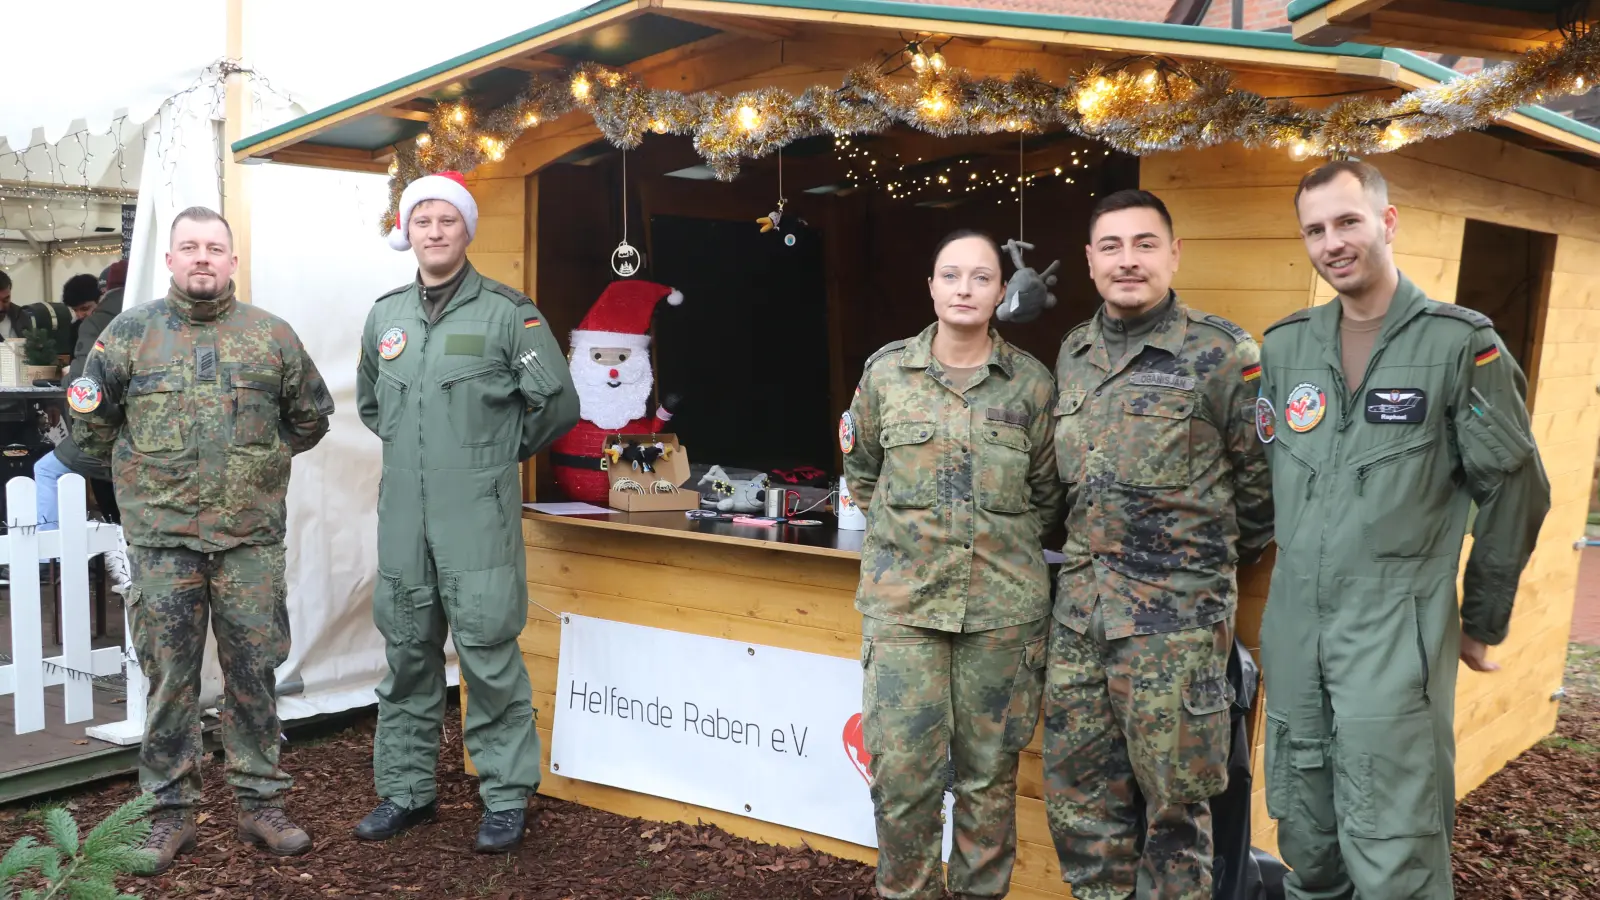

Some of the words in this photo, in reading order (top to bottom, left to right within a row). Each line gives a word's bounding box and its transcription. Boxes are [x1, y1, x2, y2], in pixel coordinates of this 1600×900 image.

[570, 680, 673, 728] Helfende
[685, 702, 760, 747] Raben
[771, 724, 808, 757] e.V.
